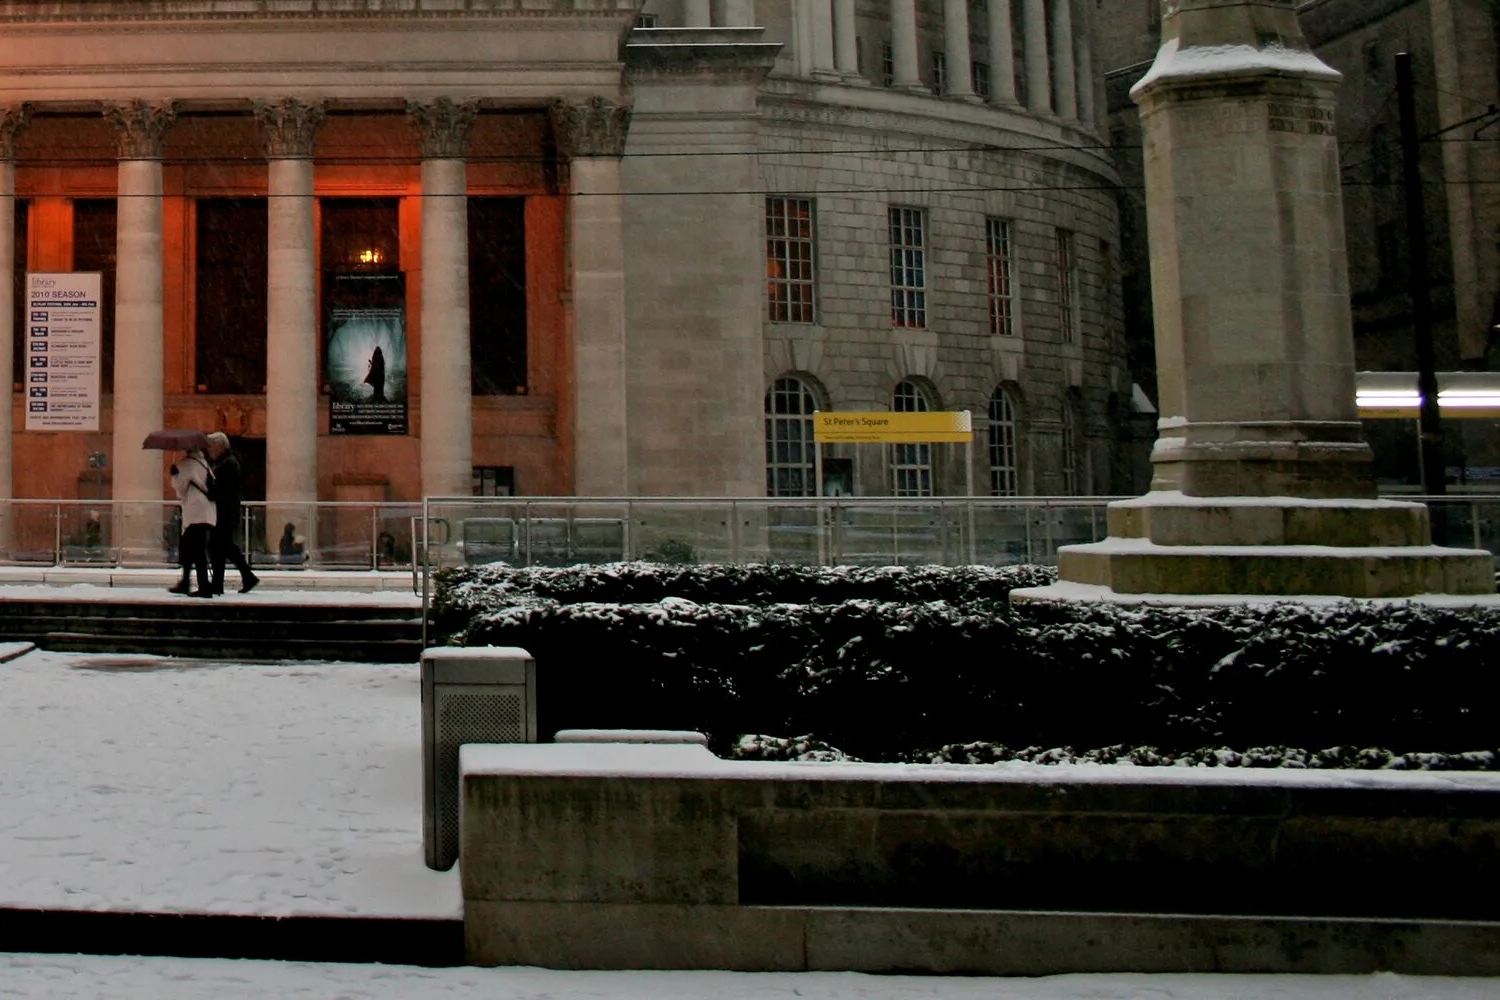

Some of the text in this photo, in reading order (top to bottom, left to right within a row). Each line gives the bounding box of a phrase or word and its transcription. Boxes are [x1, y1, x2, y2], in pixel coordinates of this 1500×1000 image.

[51, 290, 86, 298] SEASON
[332, 402, 355, 411] library
[823, 417, 889, 427] St Peter's Square
